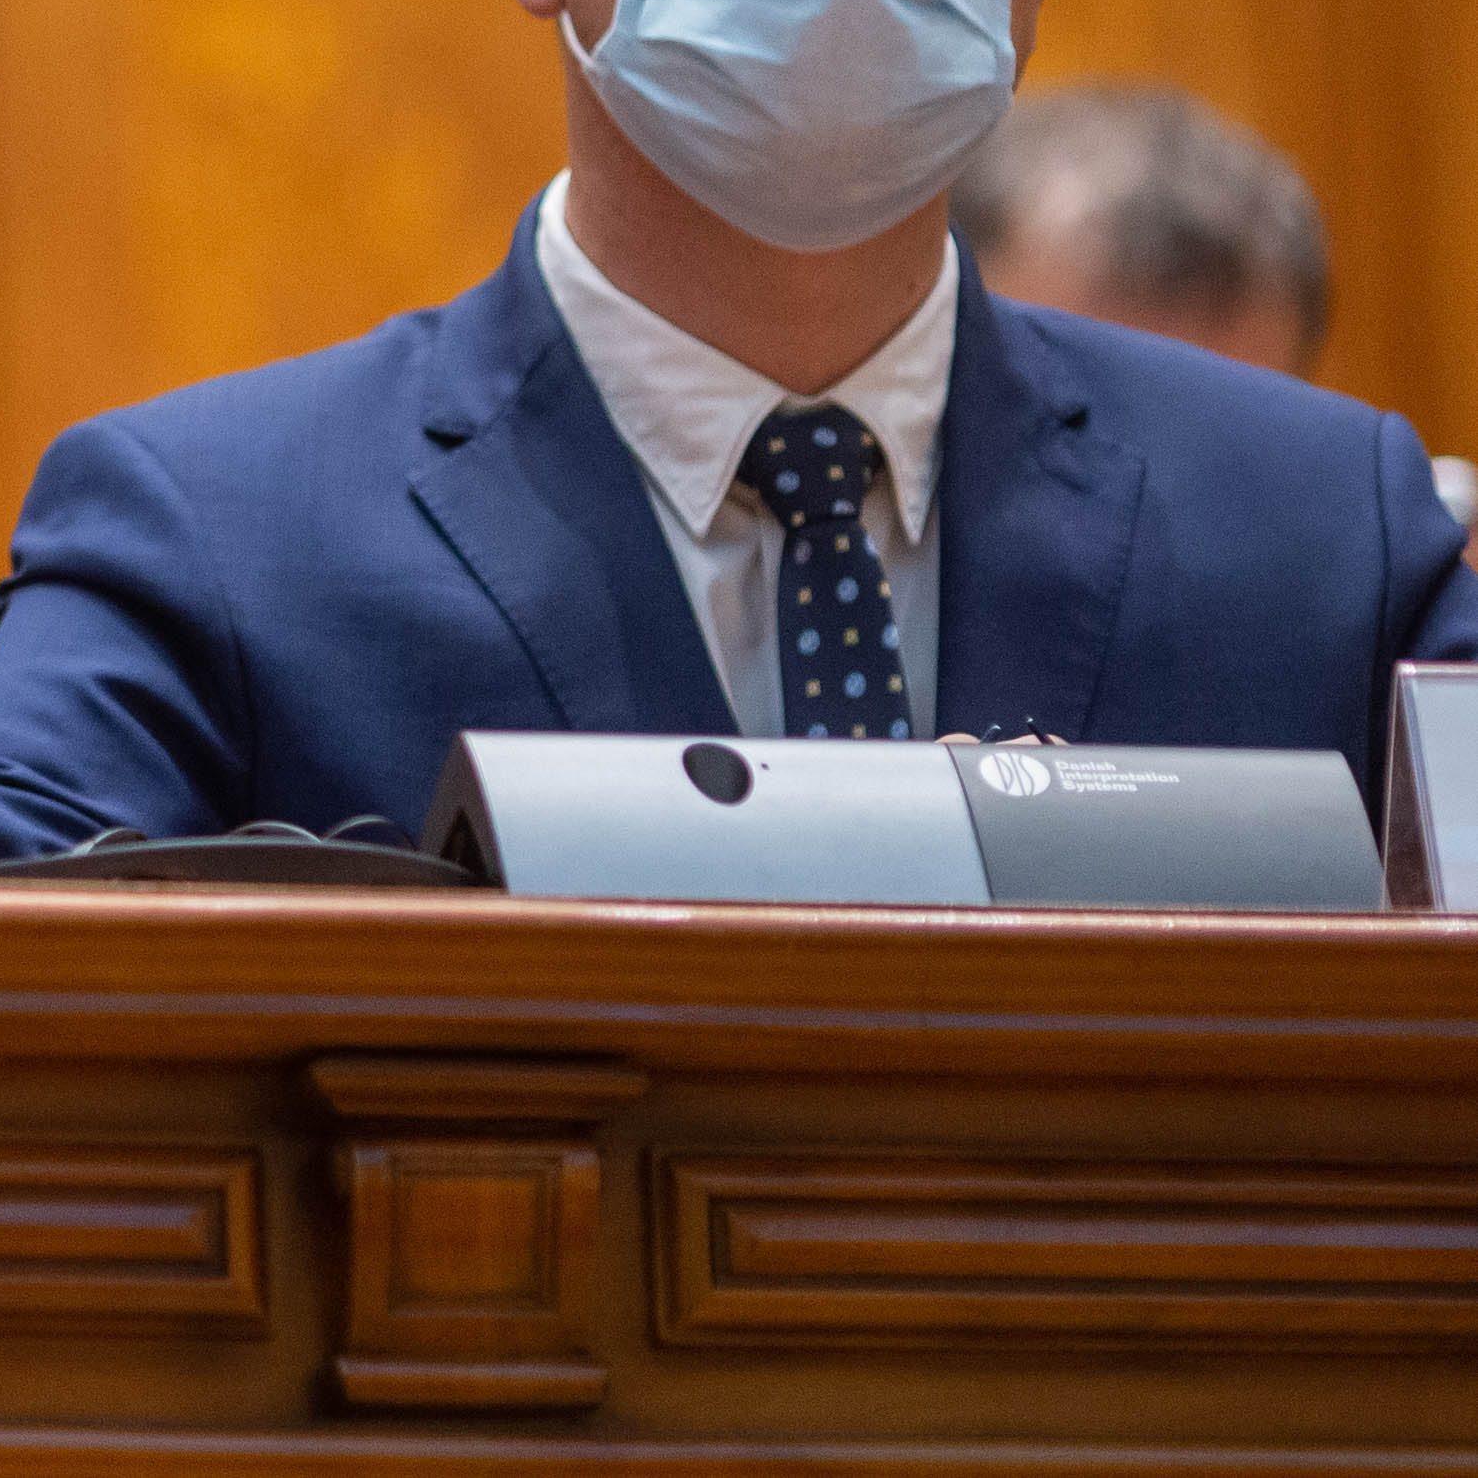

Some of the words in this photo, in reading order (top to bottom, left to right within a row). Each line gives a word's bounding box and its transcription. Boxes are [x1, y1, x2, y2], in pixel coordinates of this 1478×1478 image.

[1055, 760, 1117, 772] Danish
[1059, 770, 1181, 783] Interpretation
[1062, 780, 1139, 793] Systems
